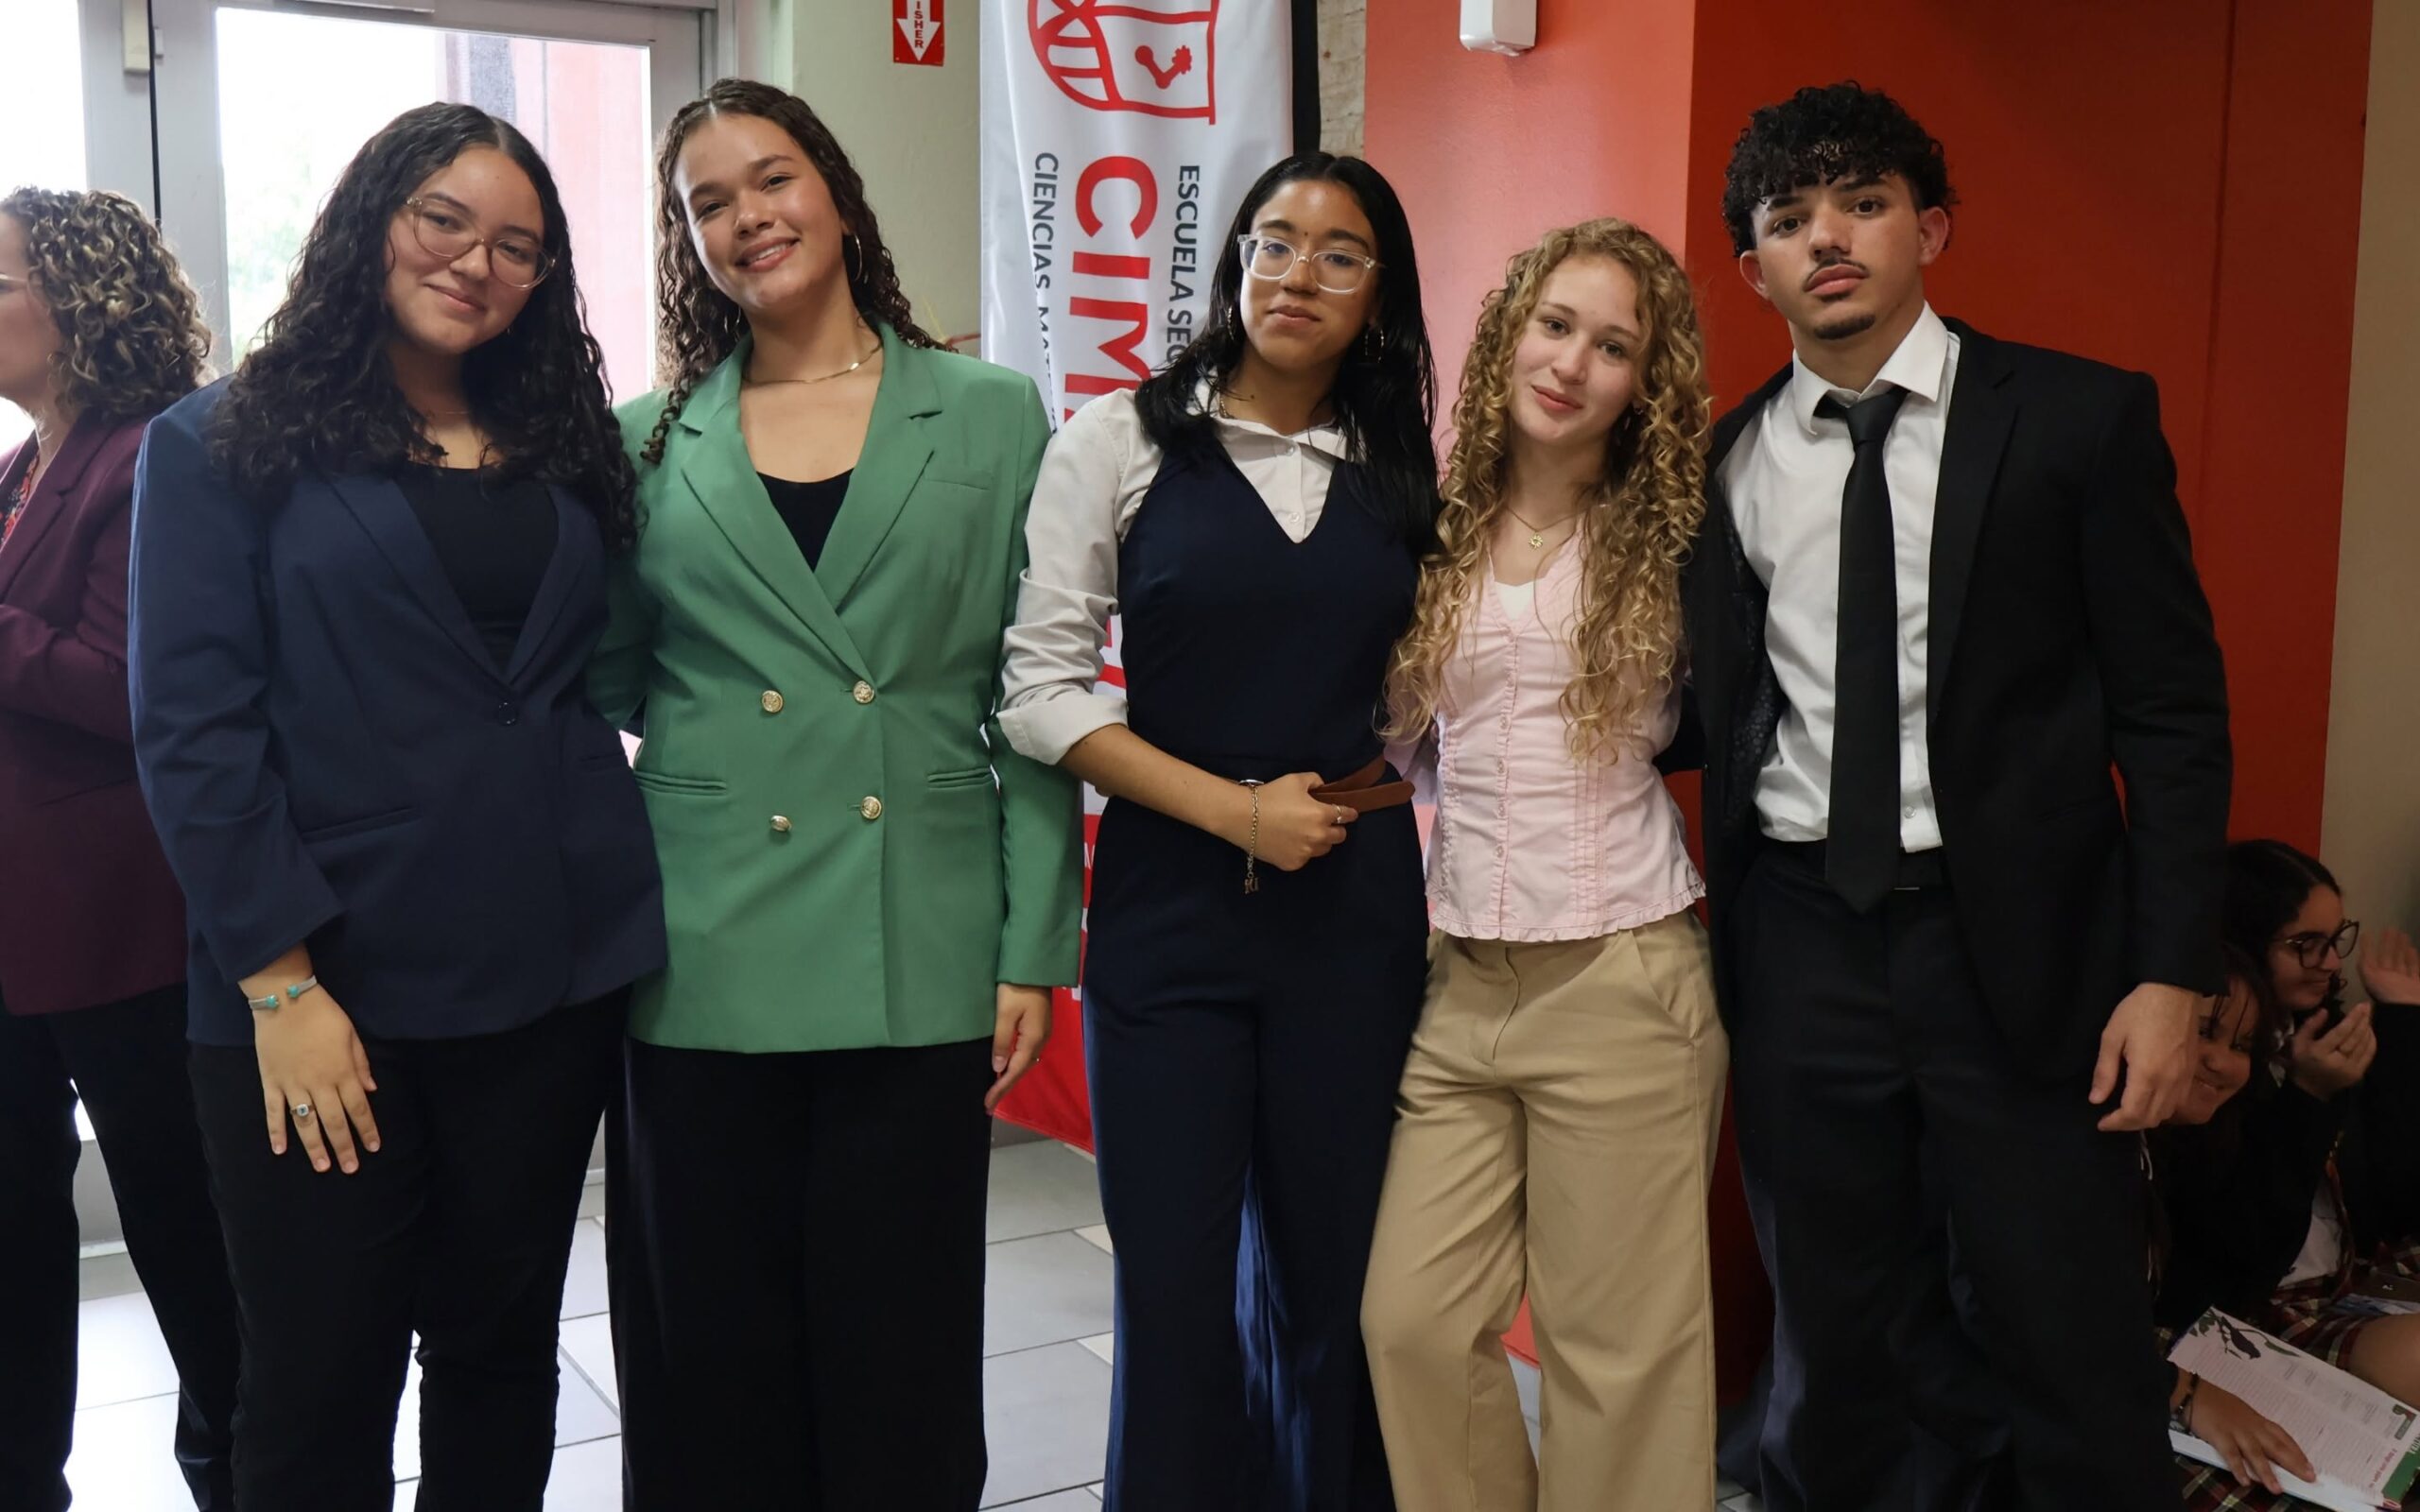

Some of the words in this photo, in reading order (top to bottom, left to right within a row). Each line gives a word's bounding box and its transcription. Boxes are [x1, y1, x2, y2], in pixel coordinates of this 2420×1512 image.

[914, 1, 924, 48] ISHER
[1032, 152, 1059, 295] CIENCIAS
[1064, 155, 1157, 422] CIM
[1168, 165, 1200, 301] ESCUELA
